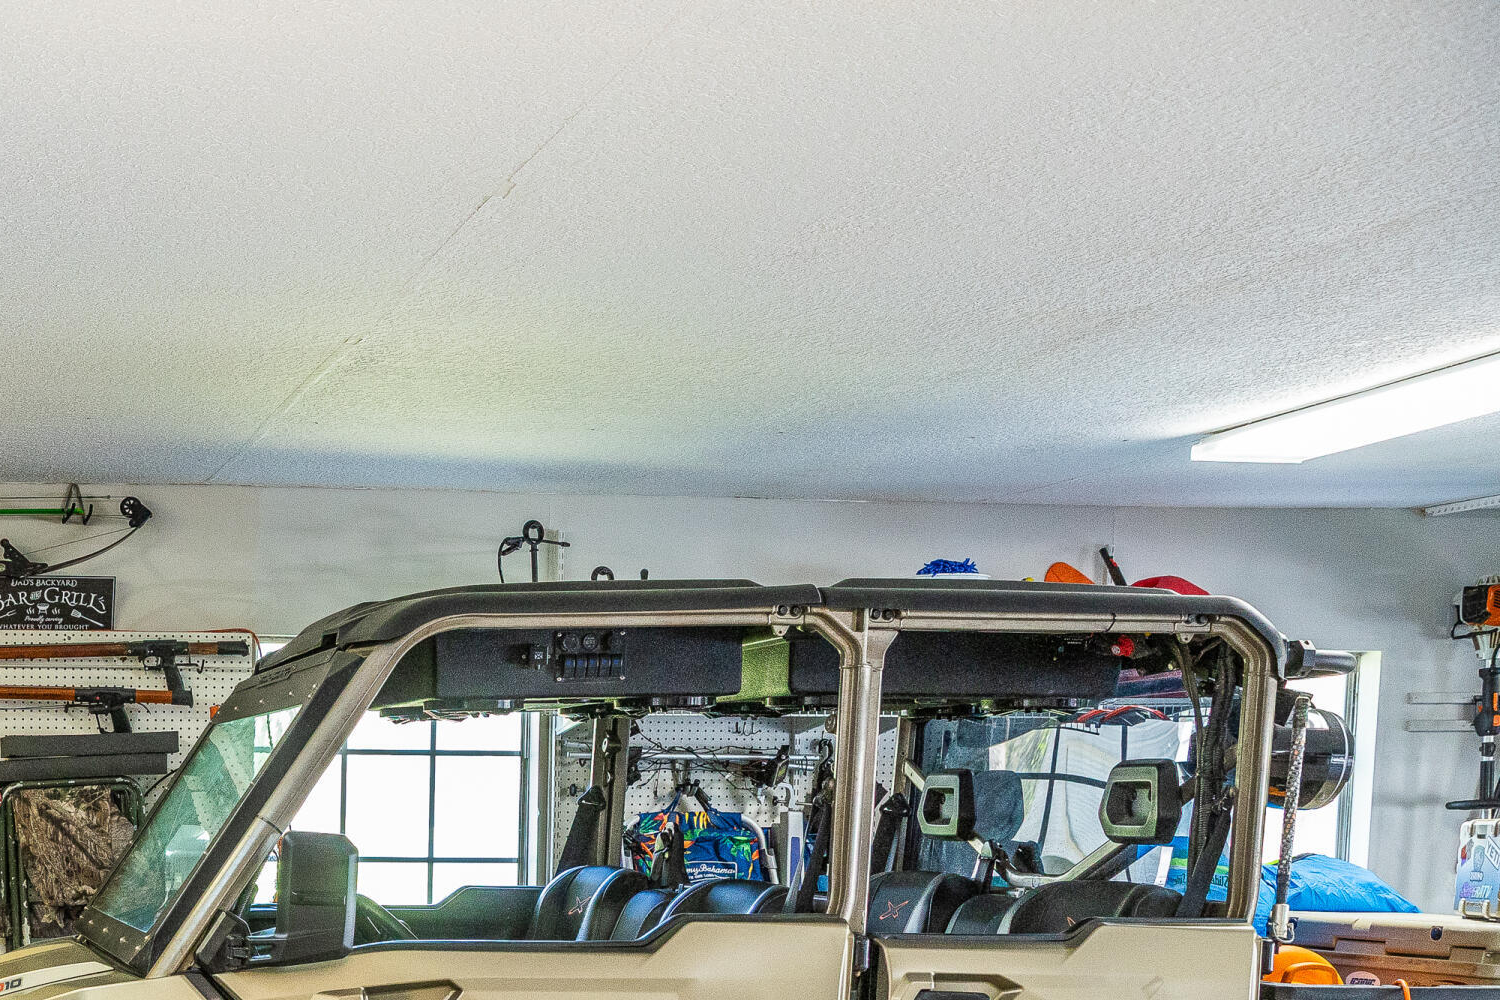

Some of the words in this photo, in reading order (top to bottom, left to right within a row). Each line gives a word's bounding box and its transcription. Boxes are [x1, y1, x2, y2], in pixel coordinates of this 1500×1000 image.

[11, 579, 34, 587] DAD'S
[36, 579, 78, 587] BACKYARD
[44, 587, 107, 614] GRILL
[700, 864, 735, 874] Bahama
